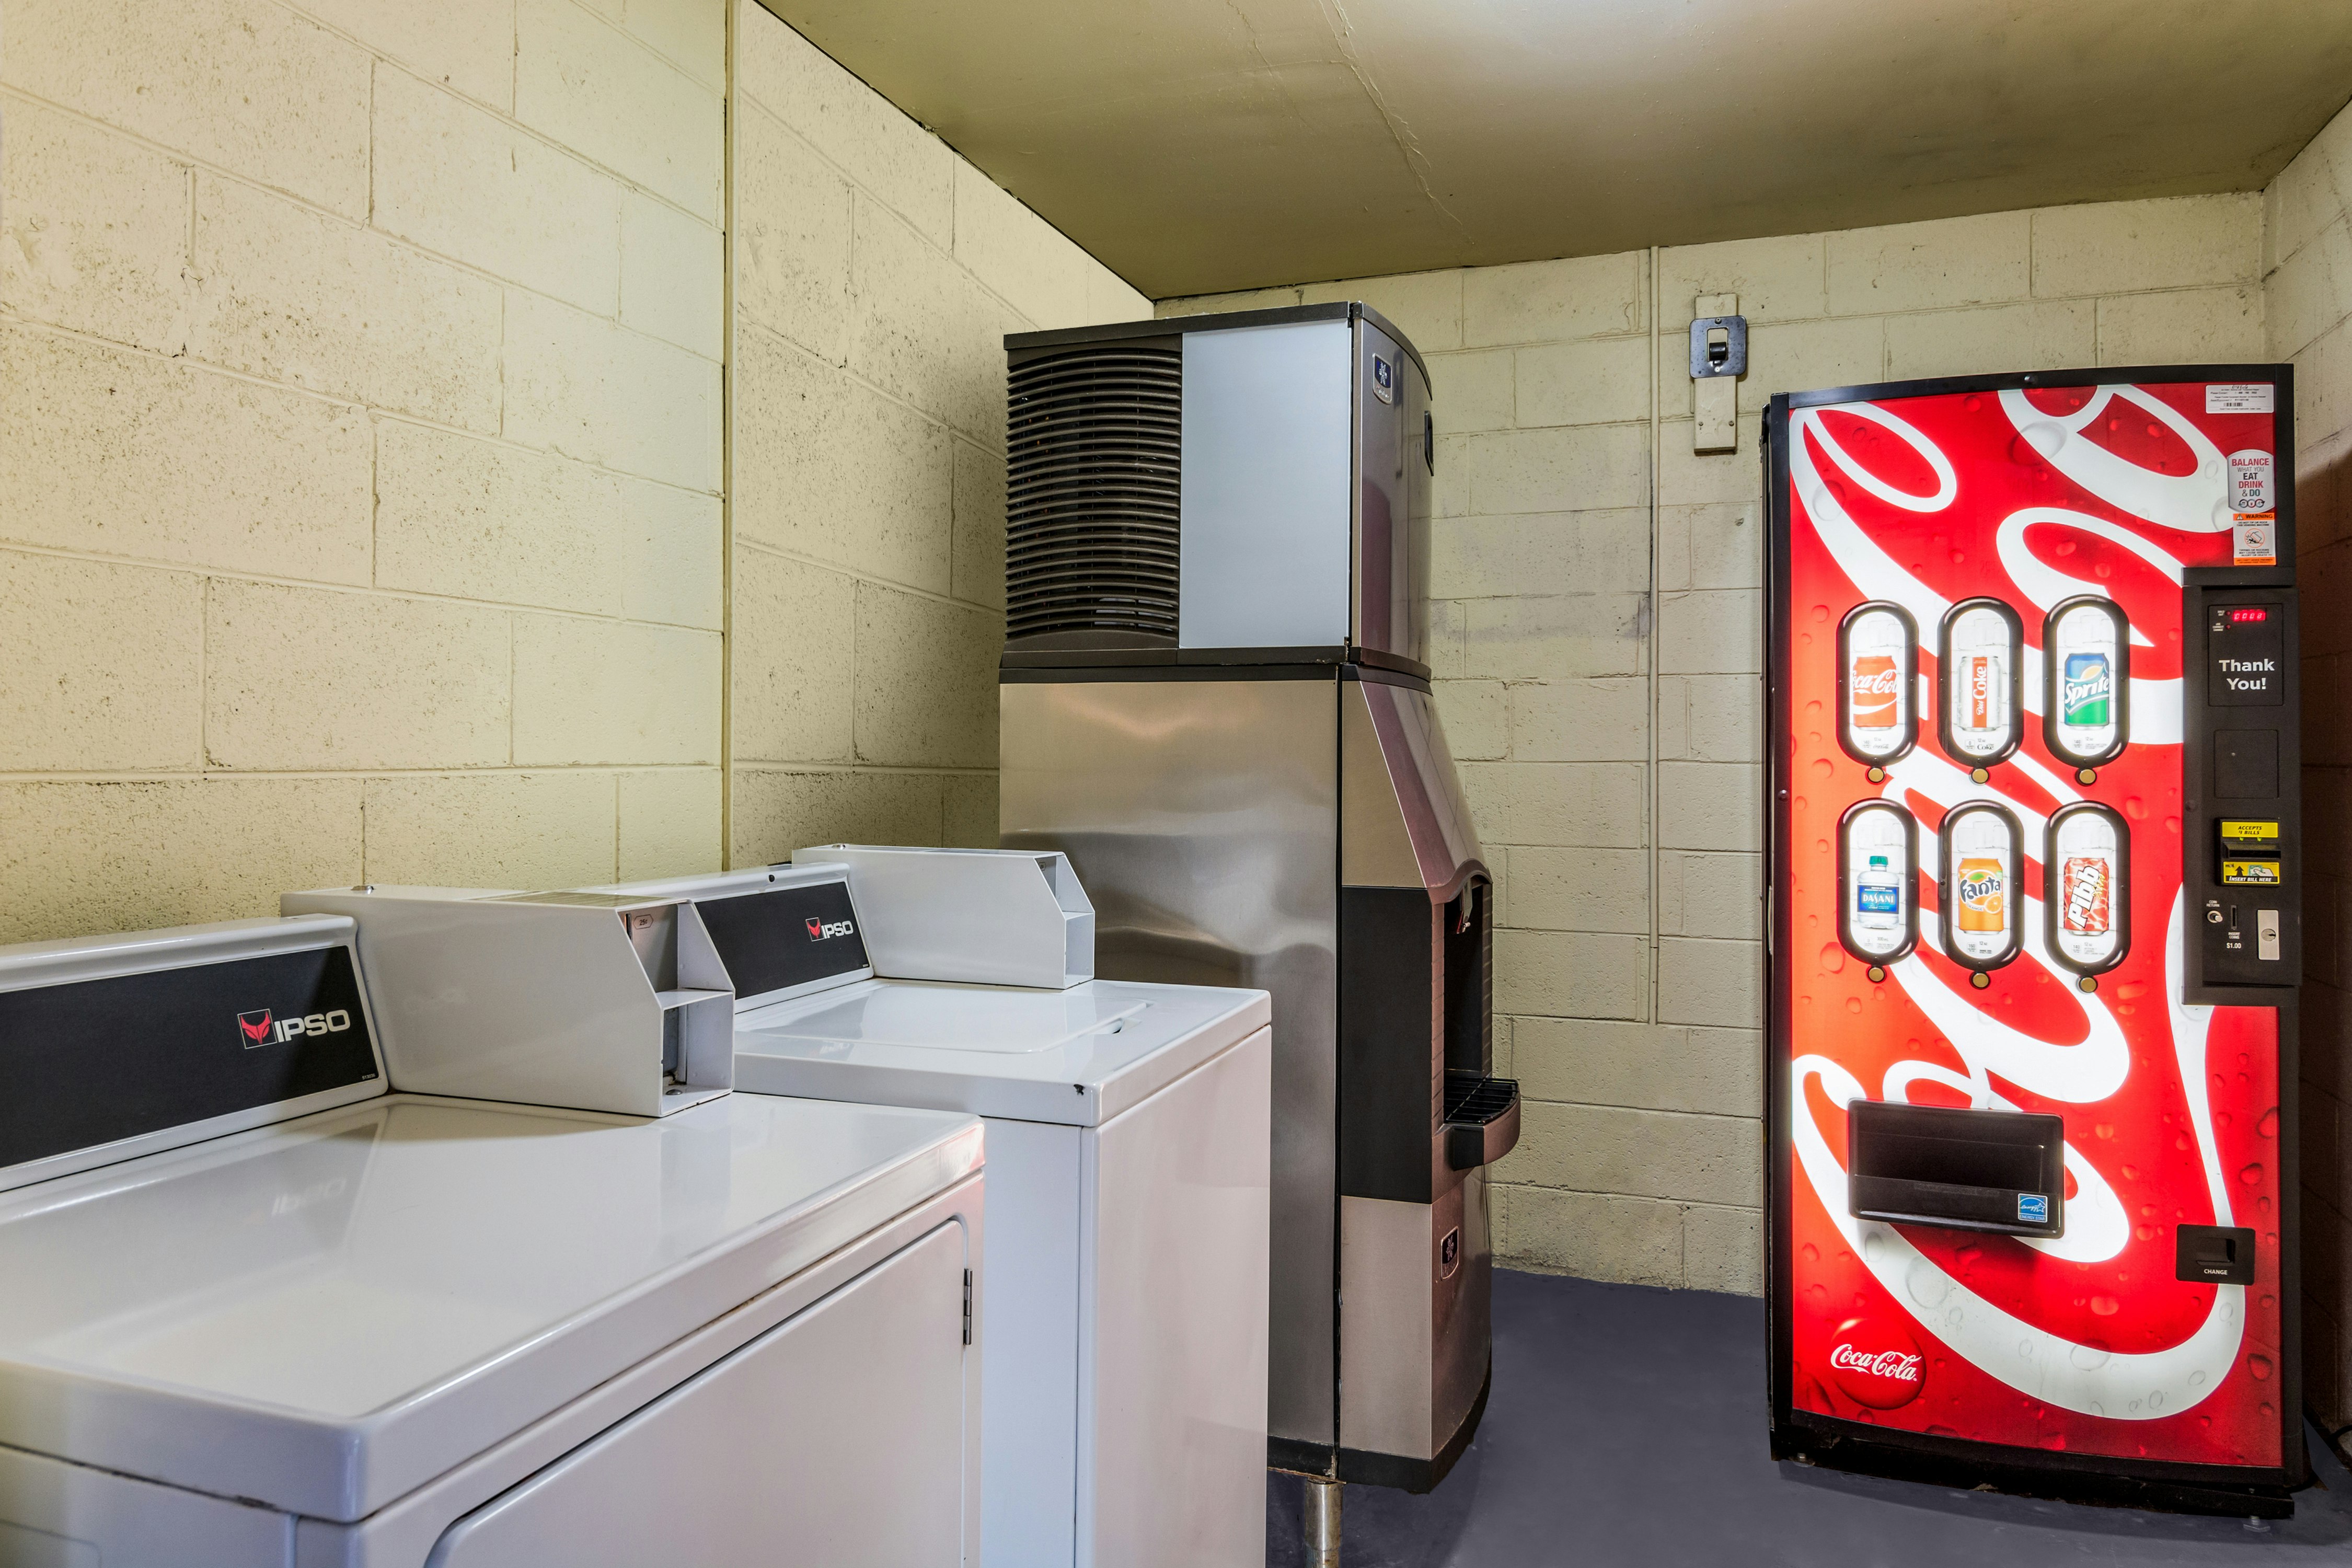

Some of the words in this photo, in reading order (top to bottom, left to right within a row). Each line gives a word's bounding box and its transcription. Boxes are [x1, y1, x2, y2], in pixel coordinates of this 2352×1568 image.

[2219, 659, 2275, 672] Thank
[1973, 666, 1987, 700] Coke
[2065, 672, 2108, 706] Sprite
[2227, 677, 2266, 690] You!
[1863, 893, 1894, 904] DASANI
[1960, 877, 2000, 903] Fanta
[2067, 866, 2100, 929] Pibb
[821, 920, 854, 939] IPSO
[274, 1009, 351, 1043] IPSO
[1830, 1344, 1922, 1380] Coca-Cola
